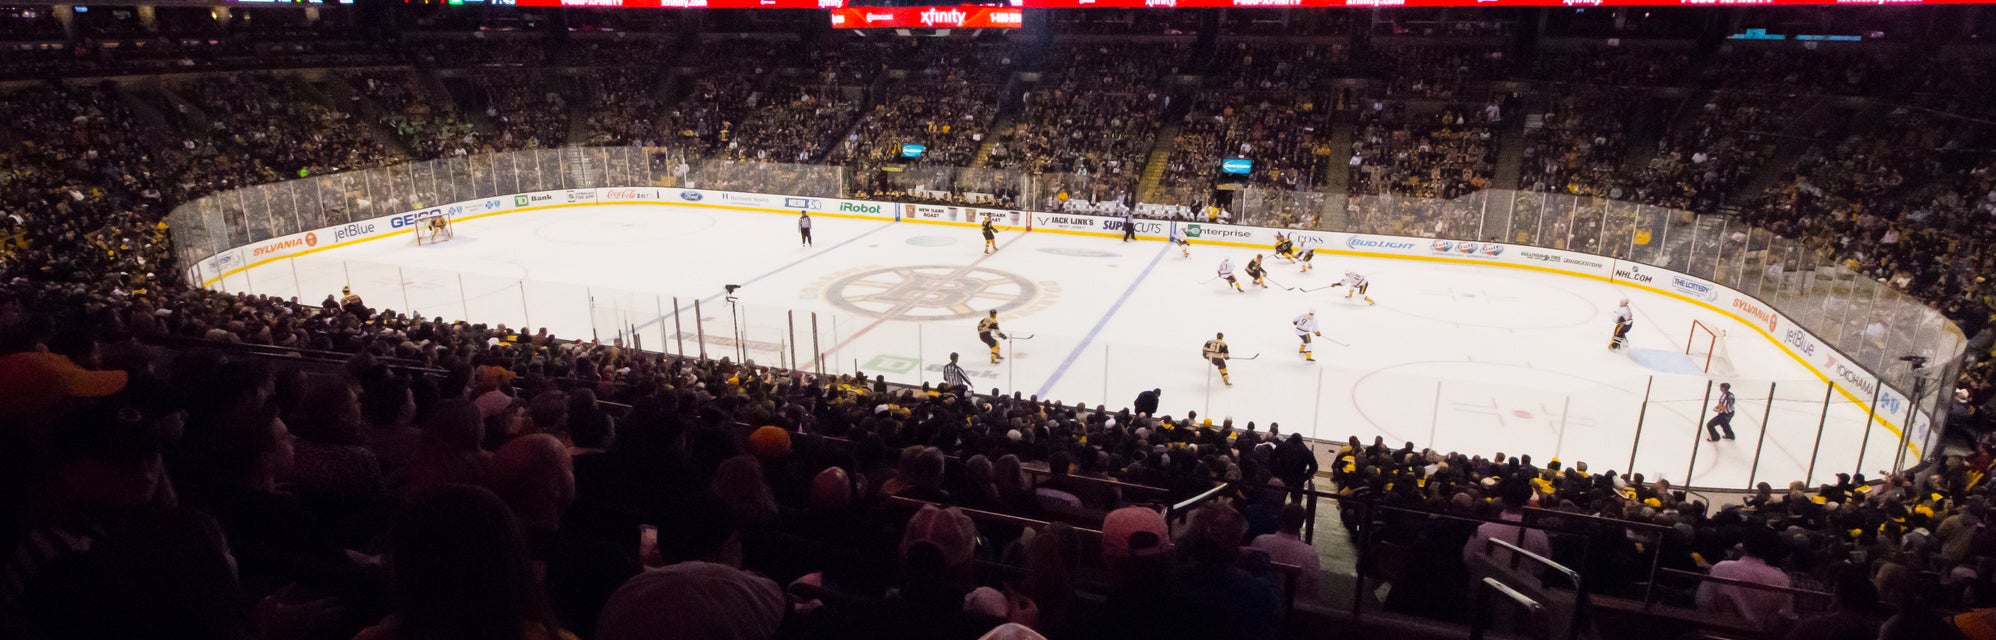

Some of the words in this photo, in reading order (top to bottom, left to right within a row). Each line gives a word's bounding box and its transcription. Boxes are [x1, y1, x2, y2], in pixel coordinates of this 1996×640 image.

[920, 8, 966, 26] xfinity
[531, 194, 552, 202] Bank
[607, 189, 636, 199] Coca-Cola
[840, 203, 881, 214] iRobot
[1070, 218, 1094, 226] LINK'S
[1103, 220, 1162, 234] SUPECUTS
[334, 223, 375, 242] jetBlue
[253, 238, 303, 257] SYLVANIA
[1350, 238, 1378, 248] BUD
[1379, 240, 1415, 250] LIGHT
[1615, 269, 1652, 283] NHL.COM
[1674, 278, 1685, 287] THE
[1686, 281, 1710, 293] LOTTERY
[1732, 298, 1769, 323] SYLVANIA
[1784, 327, 1815, 357] jetBlue
[925, 363, 1000, 379] Bnk
[1836, 363, 1875, 397] YOKOHAMA
